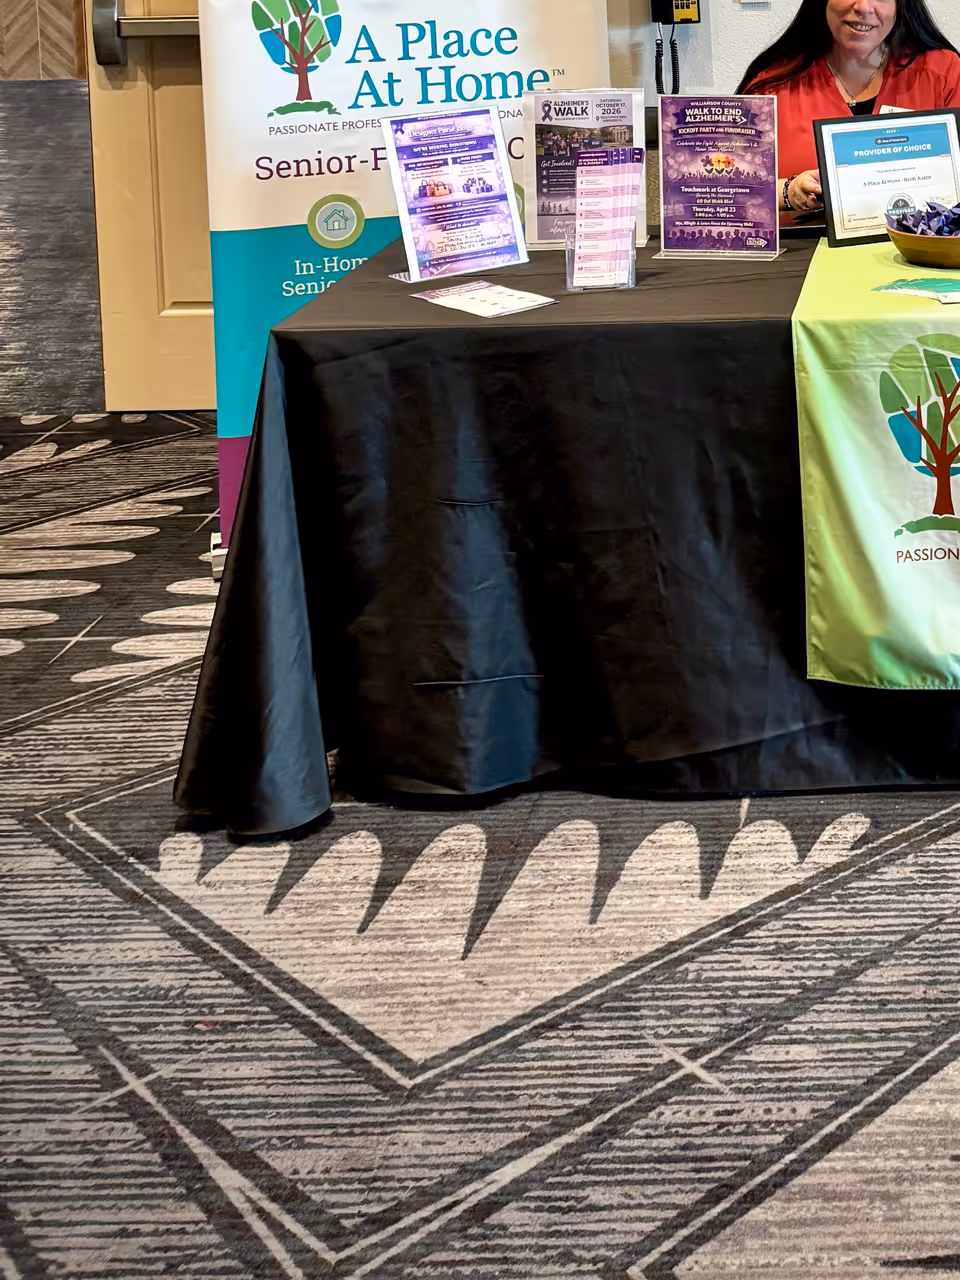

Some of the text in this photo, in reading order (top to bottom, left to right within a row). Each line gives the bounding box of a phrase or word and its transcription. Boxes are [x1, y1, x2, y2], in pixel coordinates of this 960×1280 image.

[345, 20, 518, 64] A Place
[347, 70, 404, 109] At
[415, 65, 550, 105] Home
[553, 107, 589, 116] WALK
[685, 107, 709, 115] WALK
[711, 107, 722, 115] TO
[685, 115, 742, 123] ALZHEIMER'S
[269, 122, 339, 136] PASSIONATE
[724, 127, 756, 135] FUNDRAISER
[854, 148, 892, 157] PROVIDER
[903, 143, 932, 153] CHOICE
[541, 159, 575, 168] Get Involved!
[717, 186, 750, 194] Georgetown
